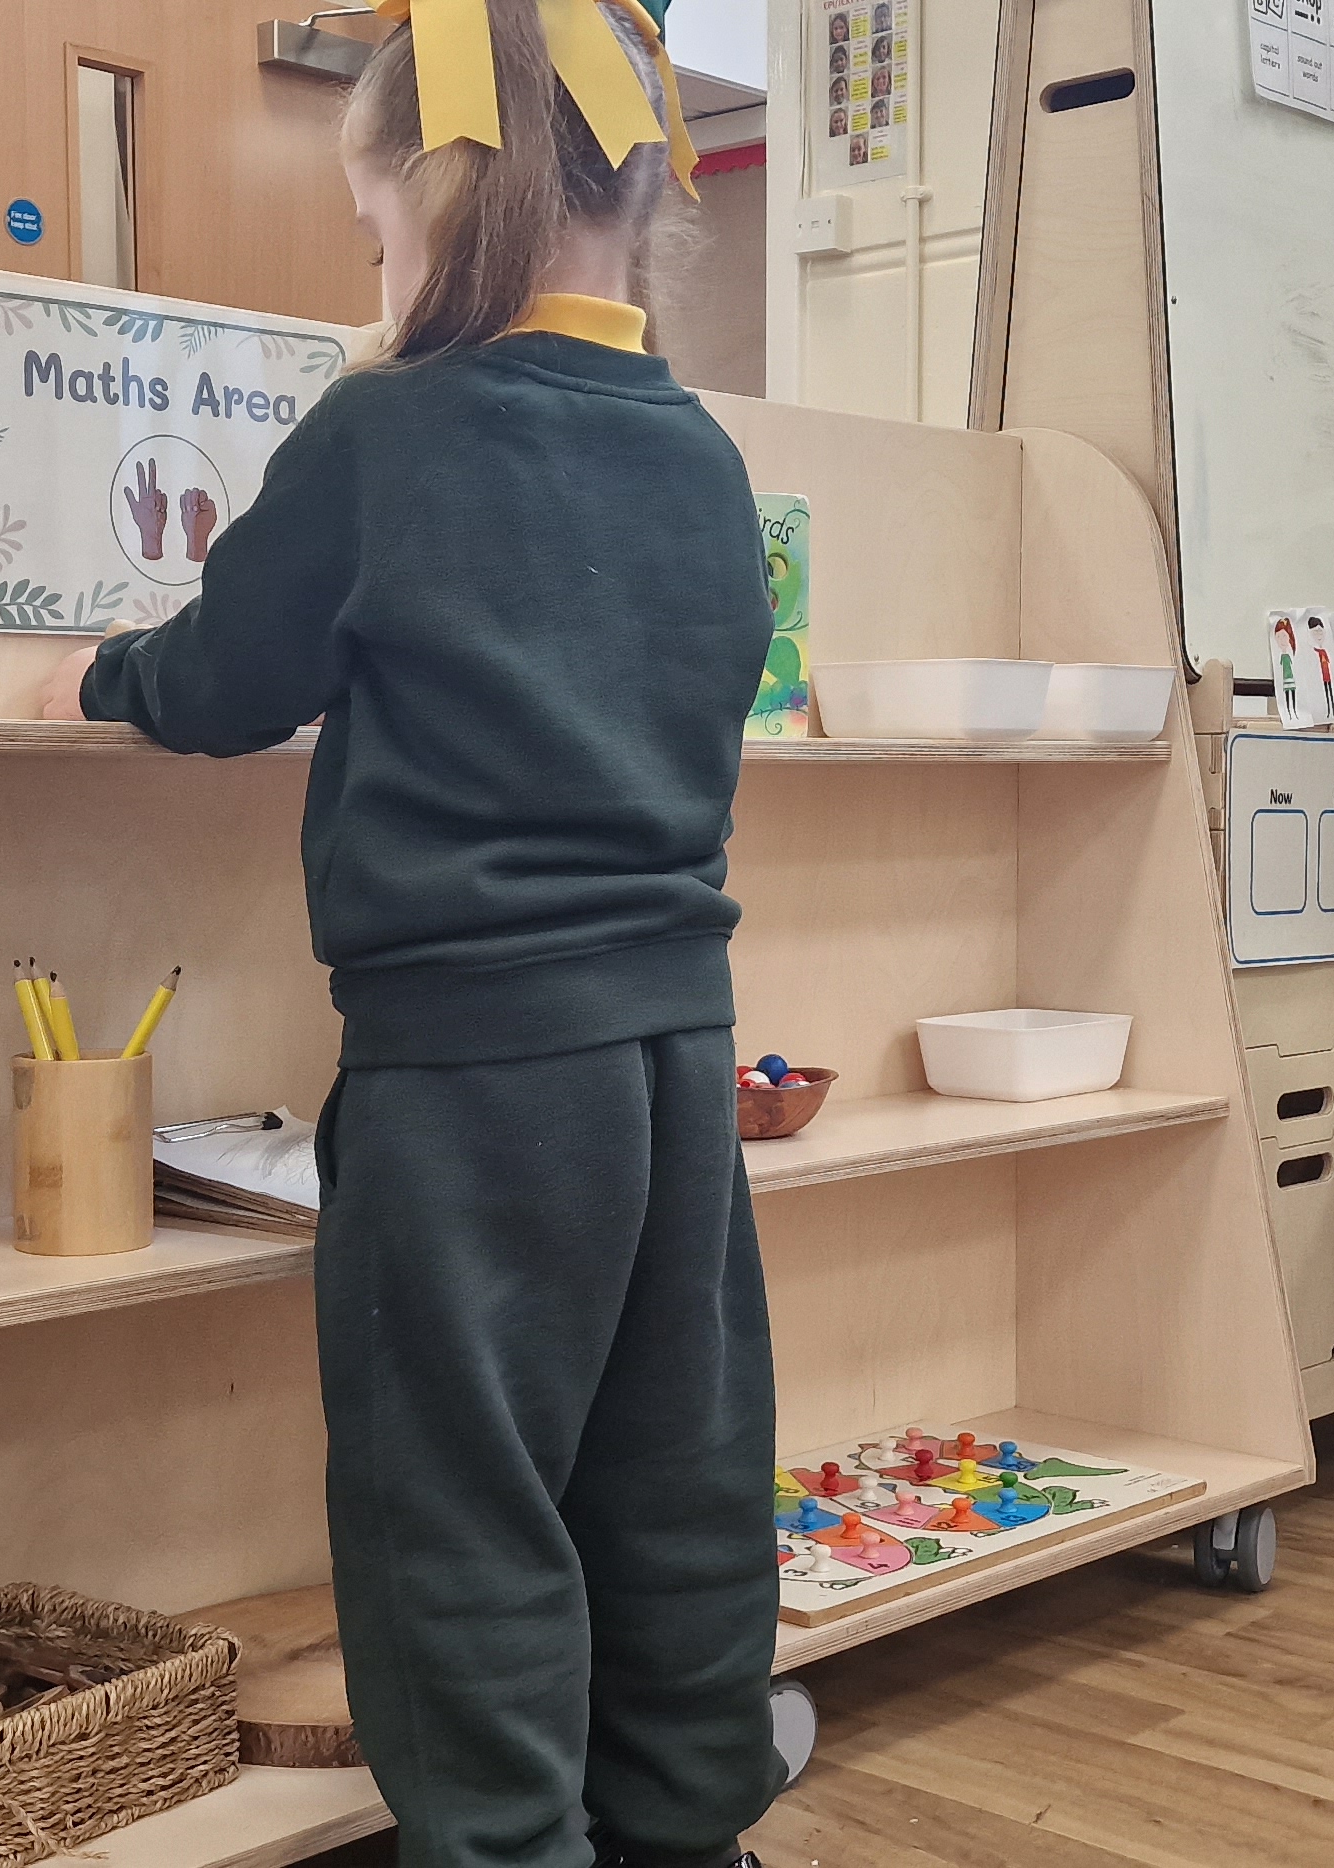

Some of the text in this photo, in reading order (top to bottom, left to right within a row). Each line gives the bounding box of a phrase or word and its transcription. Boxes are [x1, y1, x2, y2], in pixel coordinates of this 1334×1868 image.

[23, 349, 299, 426] Maths Area
[757, 507, 795, 546] irds
[1269, 789, 1293, 805] Now
[854, 1500, 881, 1511] 10
[782, 1567, 809, 1578] 3
